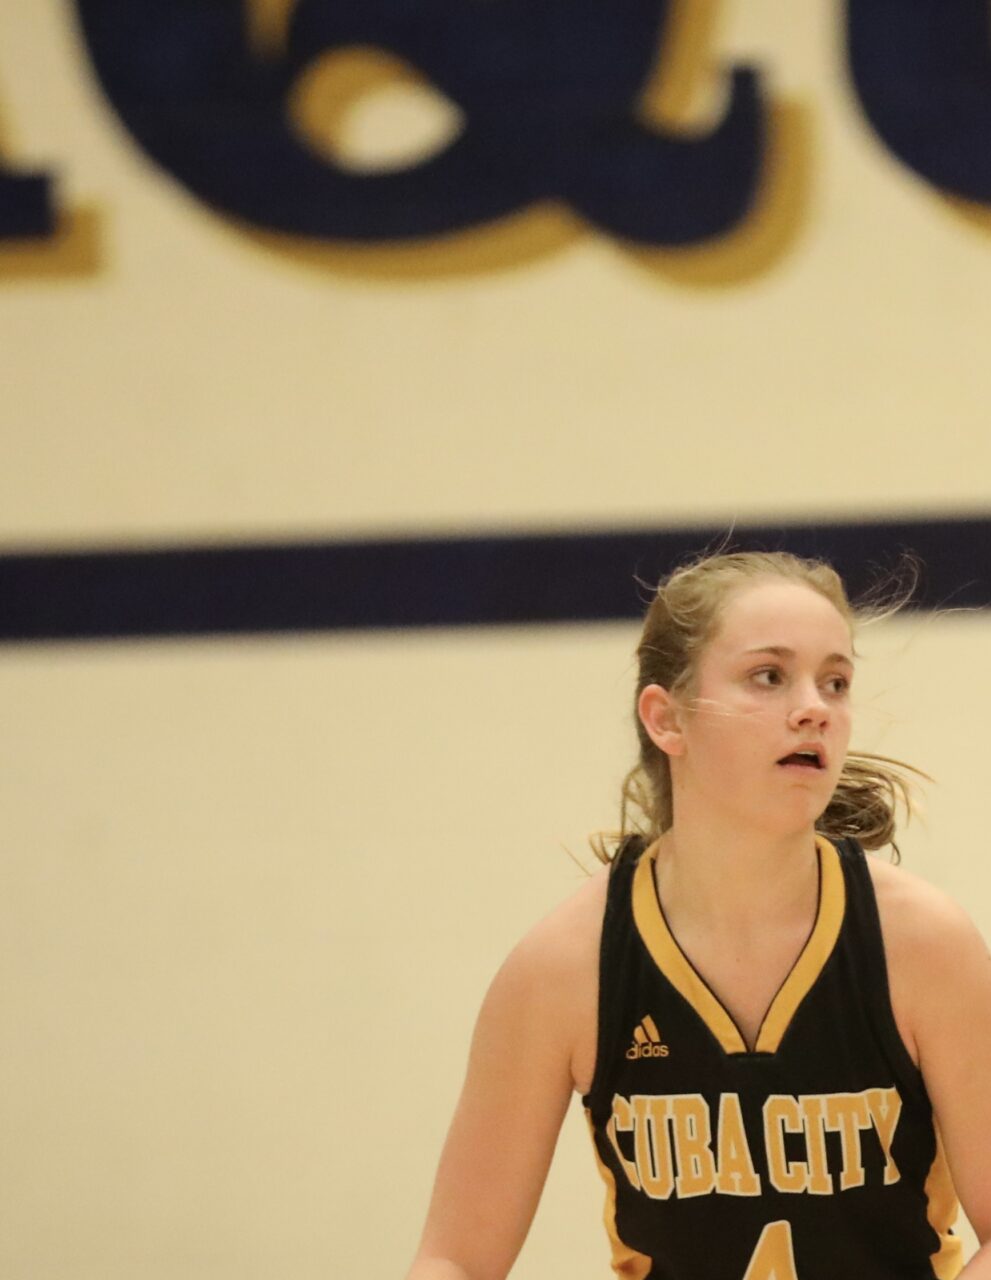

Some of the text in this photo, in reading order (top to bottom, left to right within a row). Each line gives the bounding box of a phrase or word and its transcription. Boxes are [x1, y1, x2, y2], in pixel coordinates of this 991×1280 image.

[626, 1041, 670, 1060] didas
[606, 1085, 903, 1200] CUBA CITY
